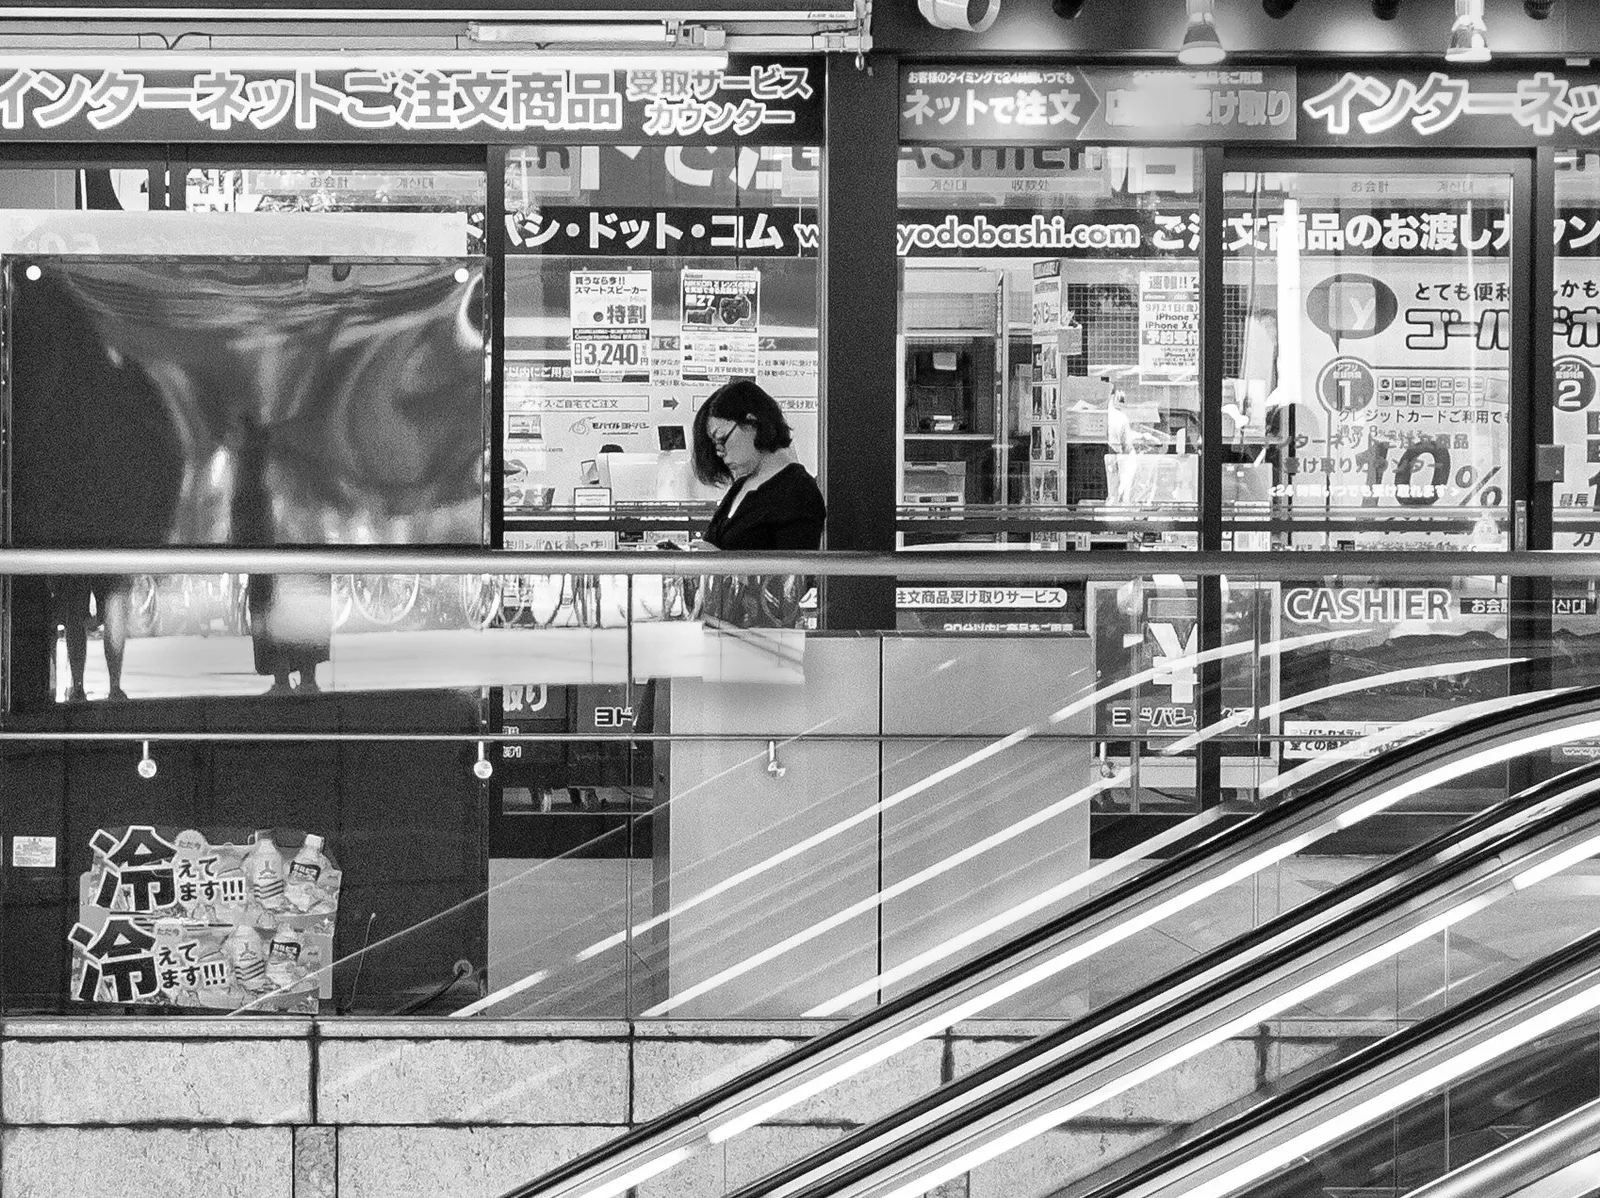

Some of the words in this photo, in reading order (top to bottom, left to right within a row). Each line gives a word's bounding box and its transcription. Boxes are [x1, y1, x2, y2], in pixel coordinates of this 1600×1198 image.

[643, 99, 795, 136] カウンター
[903, 89, 1081, 125] ネットで注文
[606, 304, 647, 325] 特割
[1145, 321, 1179, 329] iPhone
[1156, 313, 1190, 321] iPhone
[584, 343, 639, 366] 3,240
[1558, 379, 1582, 408] 2
[1338, 409, 1511, 424] クレジットカードご利用で
[1285, 587, 1452, 622] CASHIER
